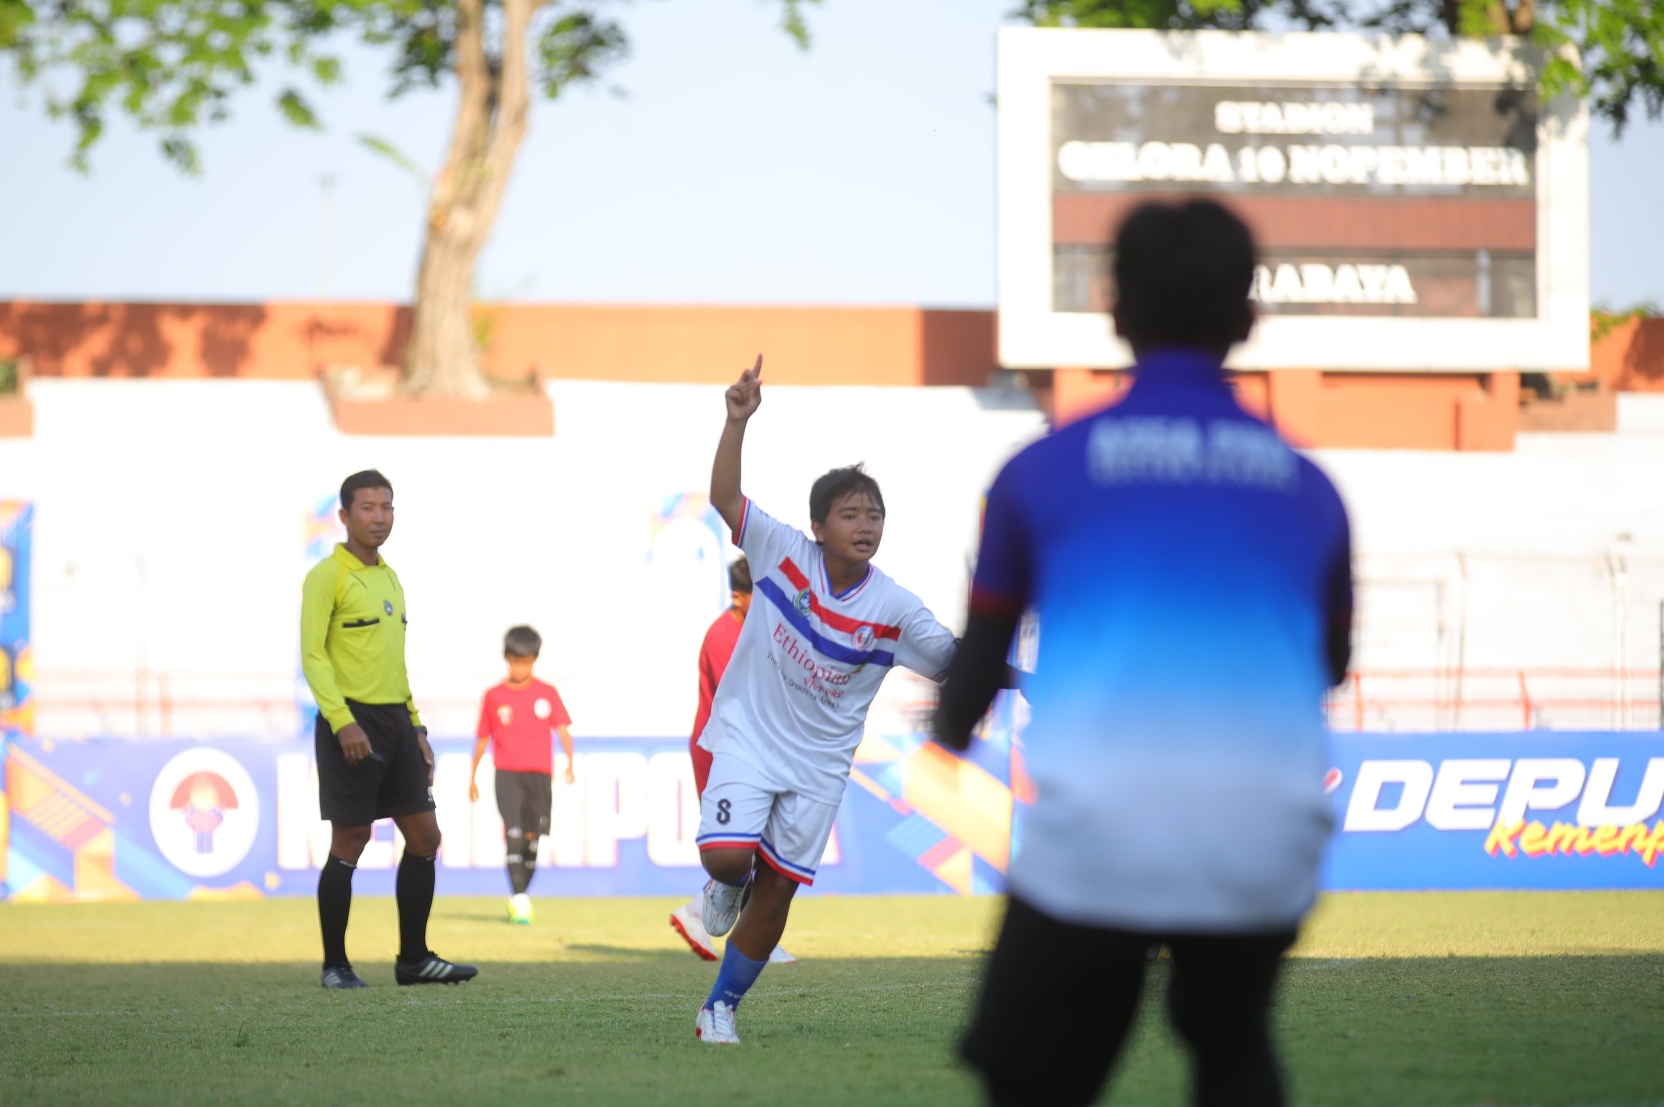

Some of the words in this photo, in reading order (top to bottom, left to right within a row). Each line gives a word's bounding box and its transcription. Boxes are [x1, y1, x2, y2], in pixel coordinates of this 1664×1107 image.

[1215, 101, 1373, 134] STADION
[1058, 141, 1233, 182] GELORA
[1239, 147, 1285, 182] 10
[1288, 145, 1528, 185] NOPEMBER
[773, 622, 851, 685] Ethiopian
[716, 798, 731, 826] 8
[1343, 757, 1664, 832] DEPU
